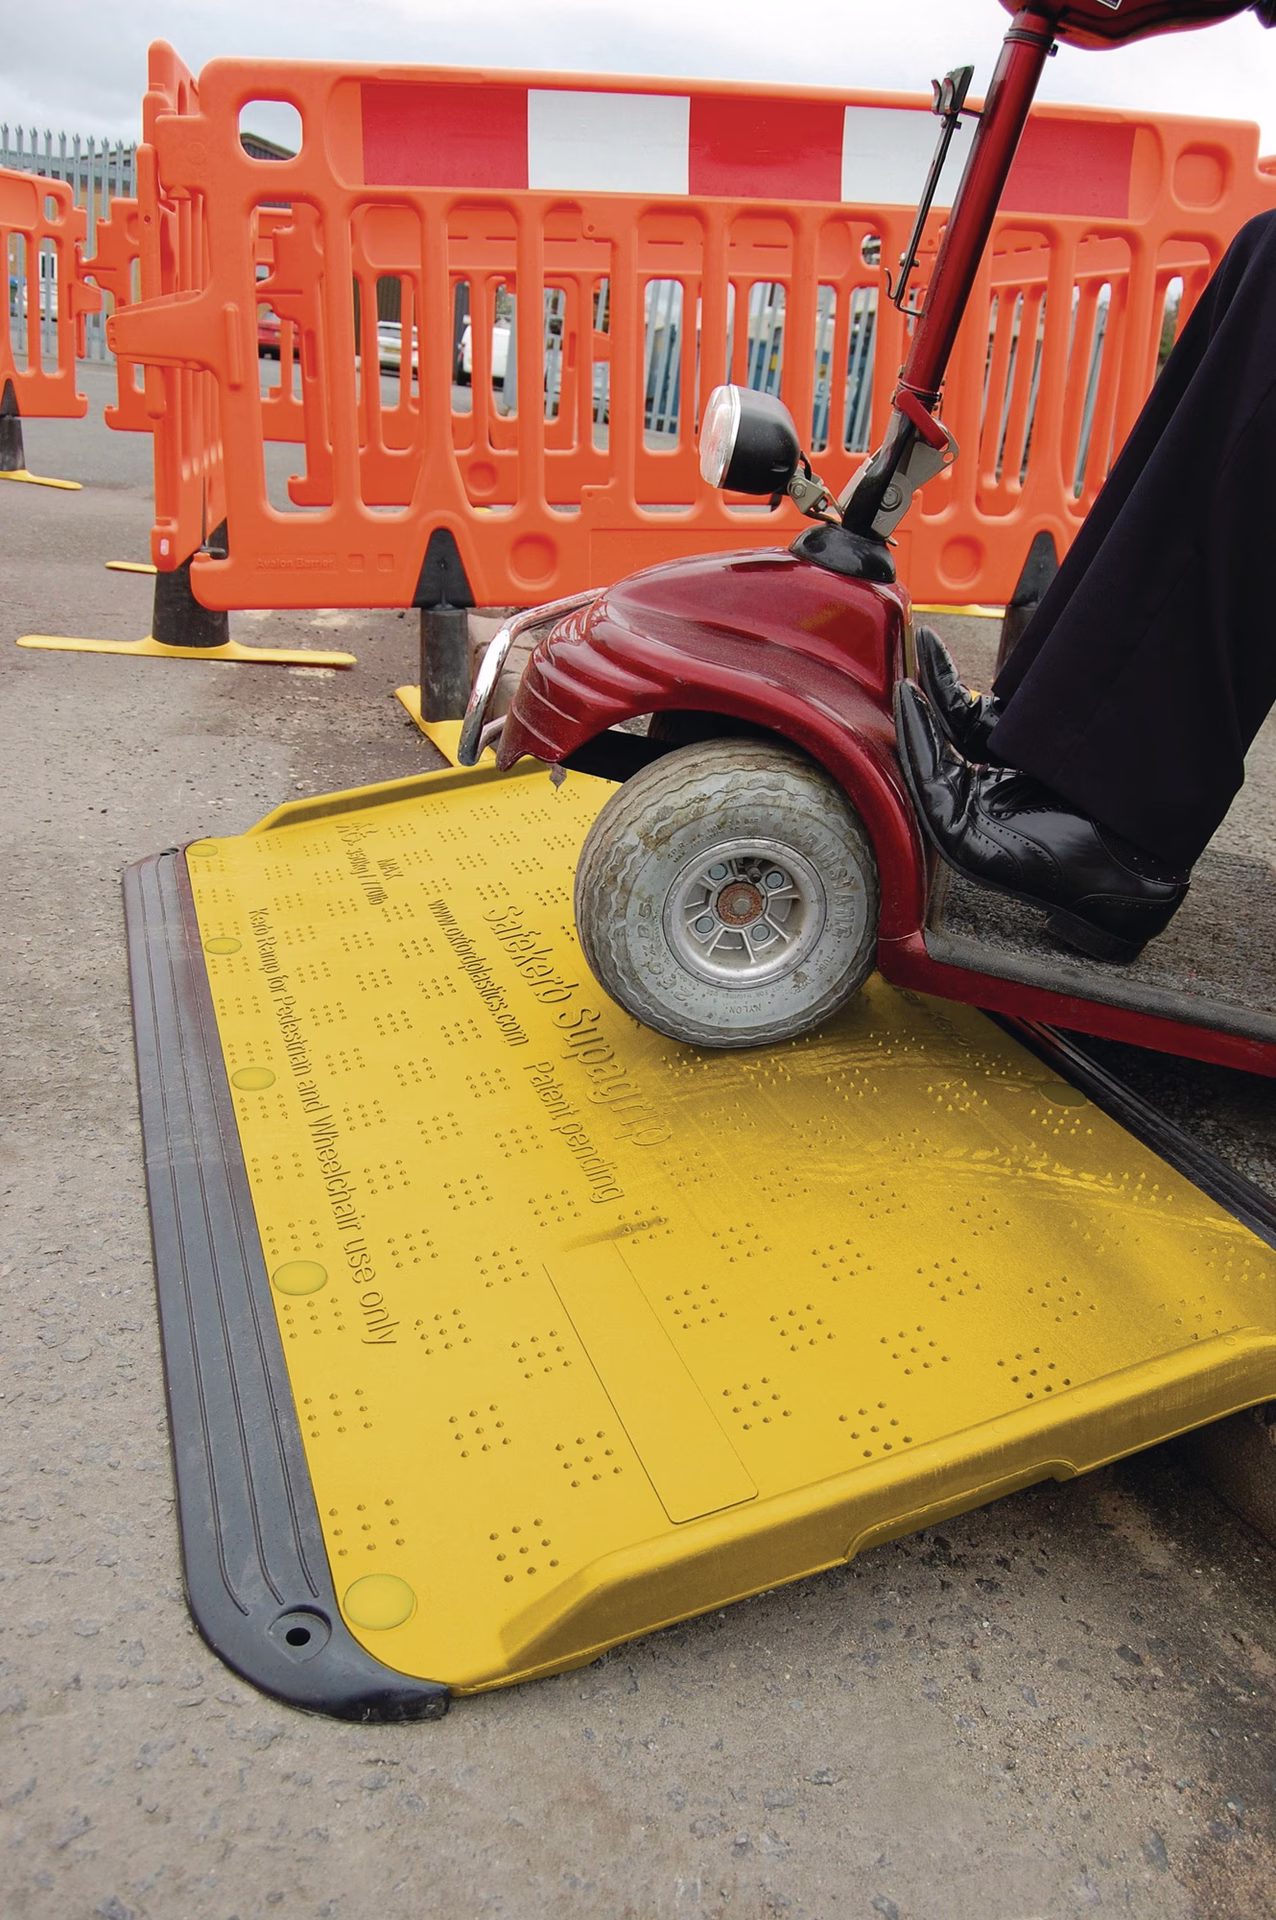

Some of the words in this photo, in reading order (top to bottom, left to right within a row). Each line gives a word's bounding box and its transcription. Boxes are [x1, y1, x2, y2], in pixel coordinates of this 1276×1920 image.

[255, 557, 293, 570] Avalon
[376, 857, 405, 881] MAX
[248, 907, 275, 937] Kerb
[256, 936, 278, 974] Ramp
[427, 898, 530, 1048] www.oxfordplastics.com
[266, 974, 290, 993] for
[272, 995, 313, 1078] Pedestrian
[481, 904, 580, 1004] Safekerb
[550, 1007, 673, 1147] Supagrip
[296, 1079, 331, 1114] and
[522, 1060, 581, 1120] Patent
[307, 1114, 367, 1231] Wheelchair
[549, 1120, 626, 1205] pending
[342, 1237, 377, 1285] use
[359, 1290, 401, 1345] only
